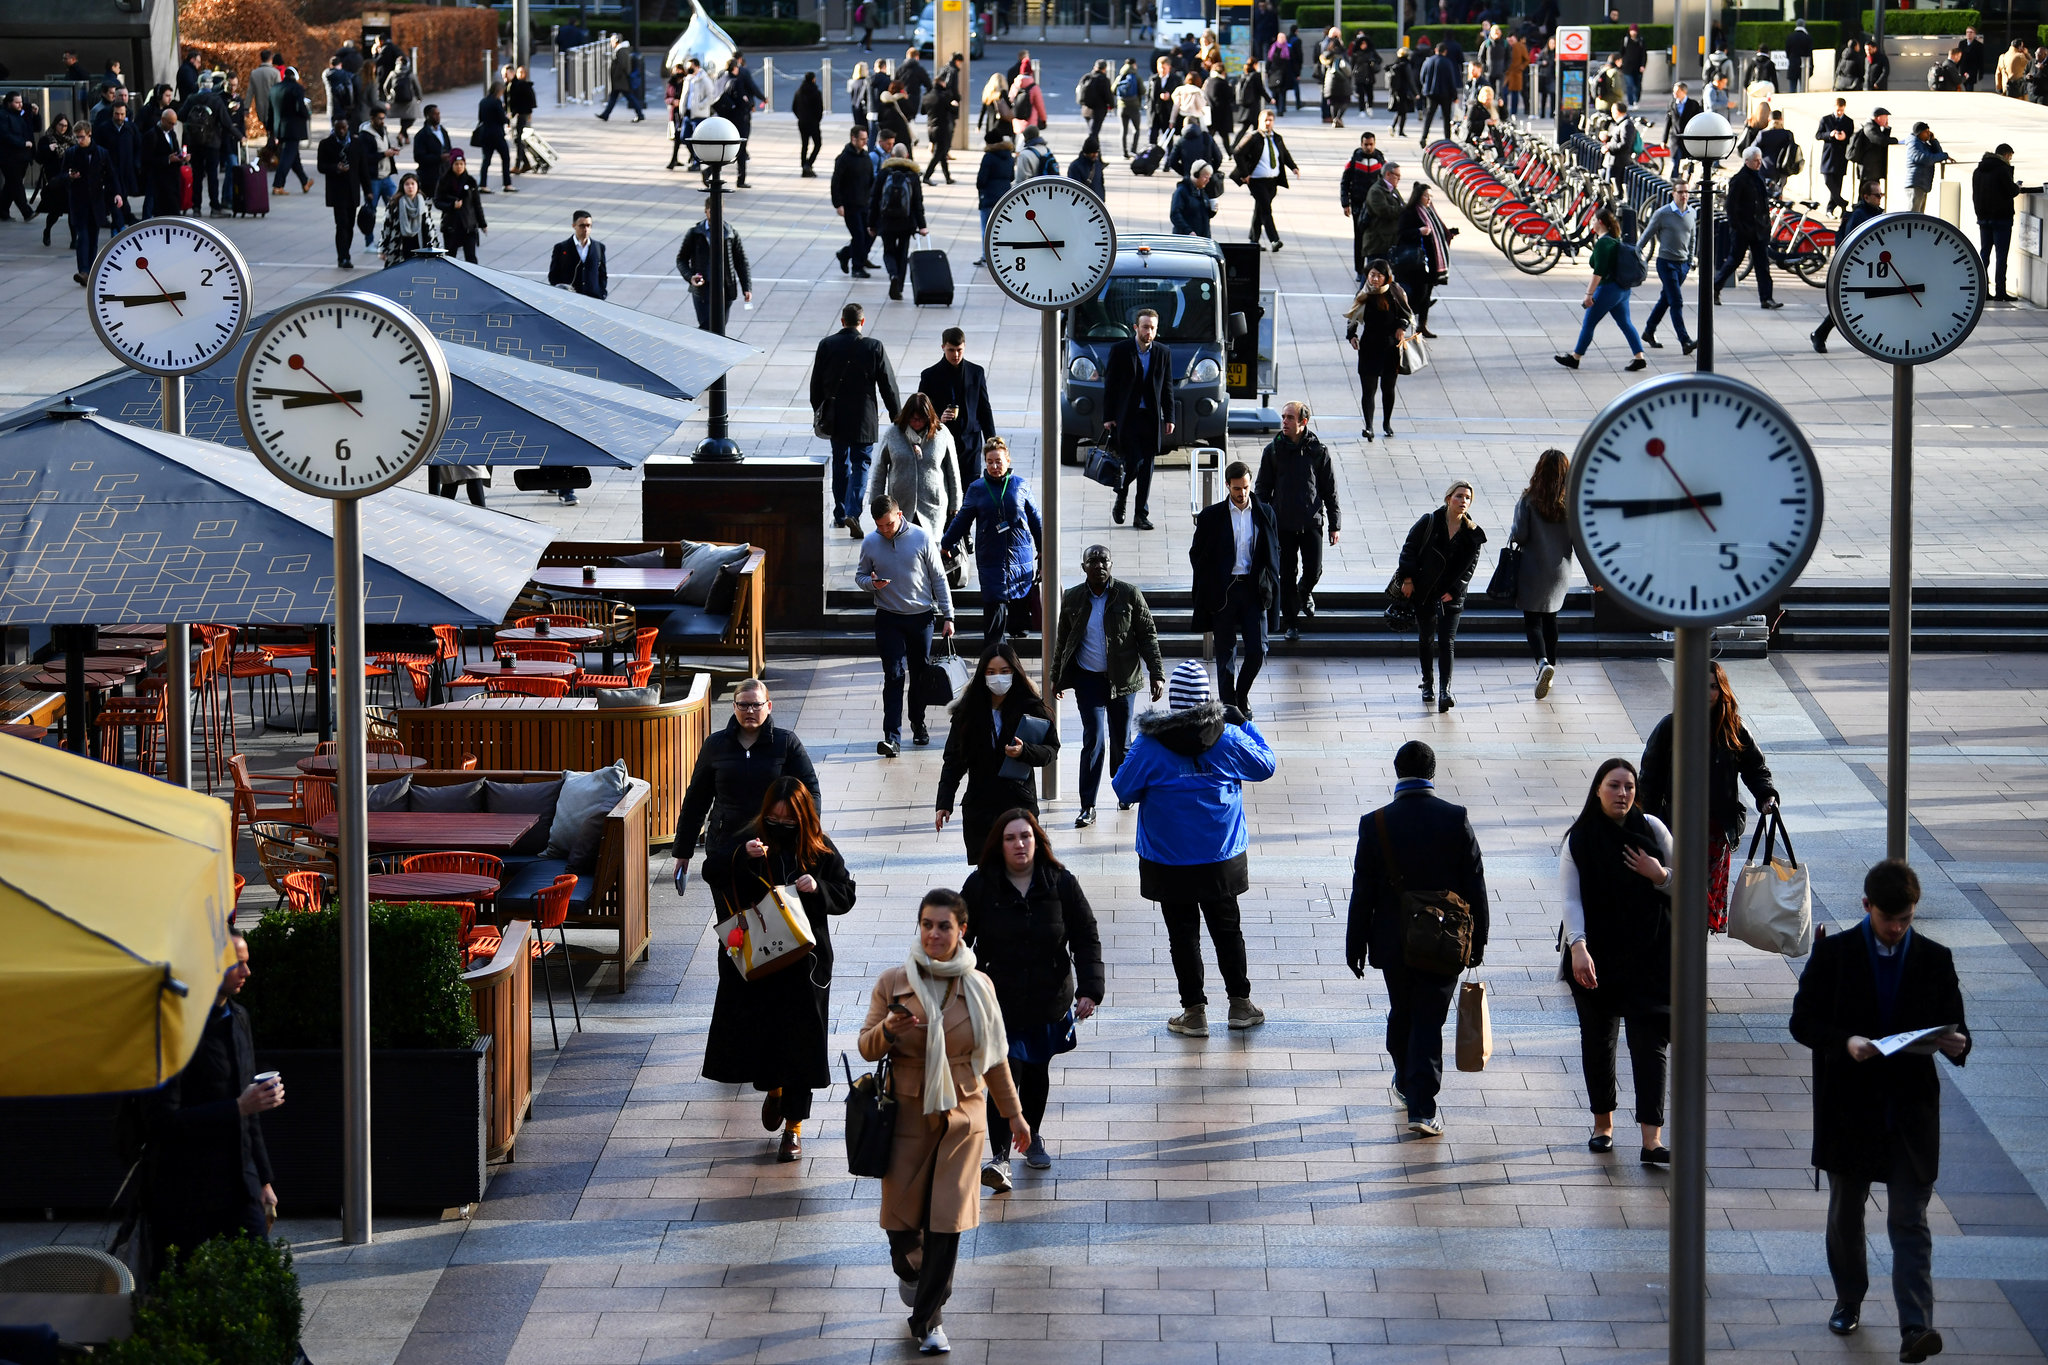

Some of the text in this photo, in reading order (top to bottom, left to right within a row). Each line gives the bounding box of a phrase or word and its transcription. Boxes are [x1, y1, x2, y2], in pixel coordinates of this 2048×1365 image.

[1015, 256, 1026, 272] 8
[1866, 261, 1889, 280] 10
[201, 269, 214, 287] 2
[335, 438, 351, 461] 6
[1719, 542, 1739, 571] 5
